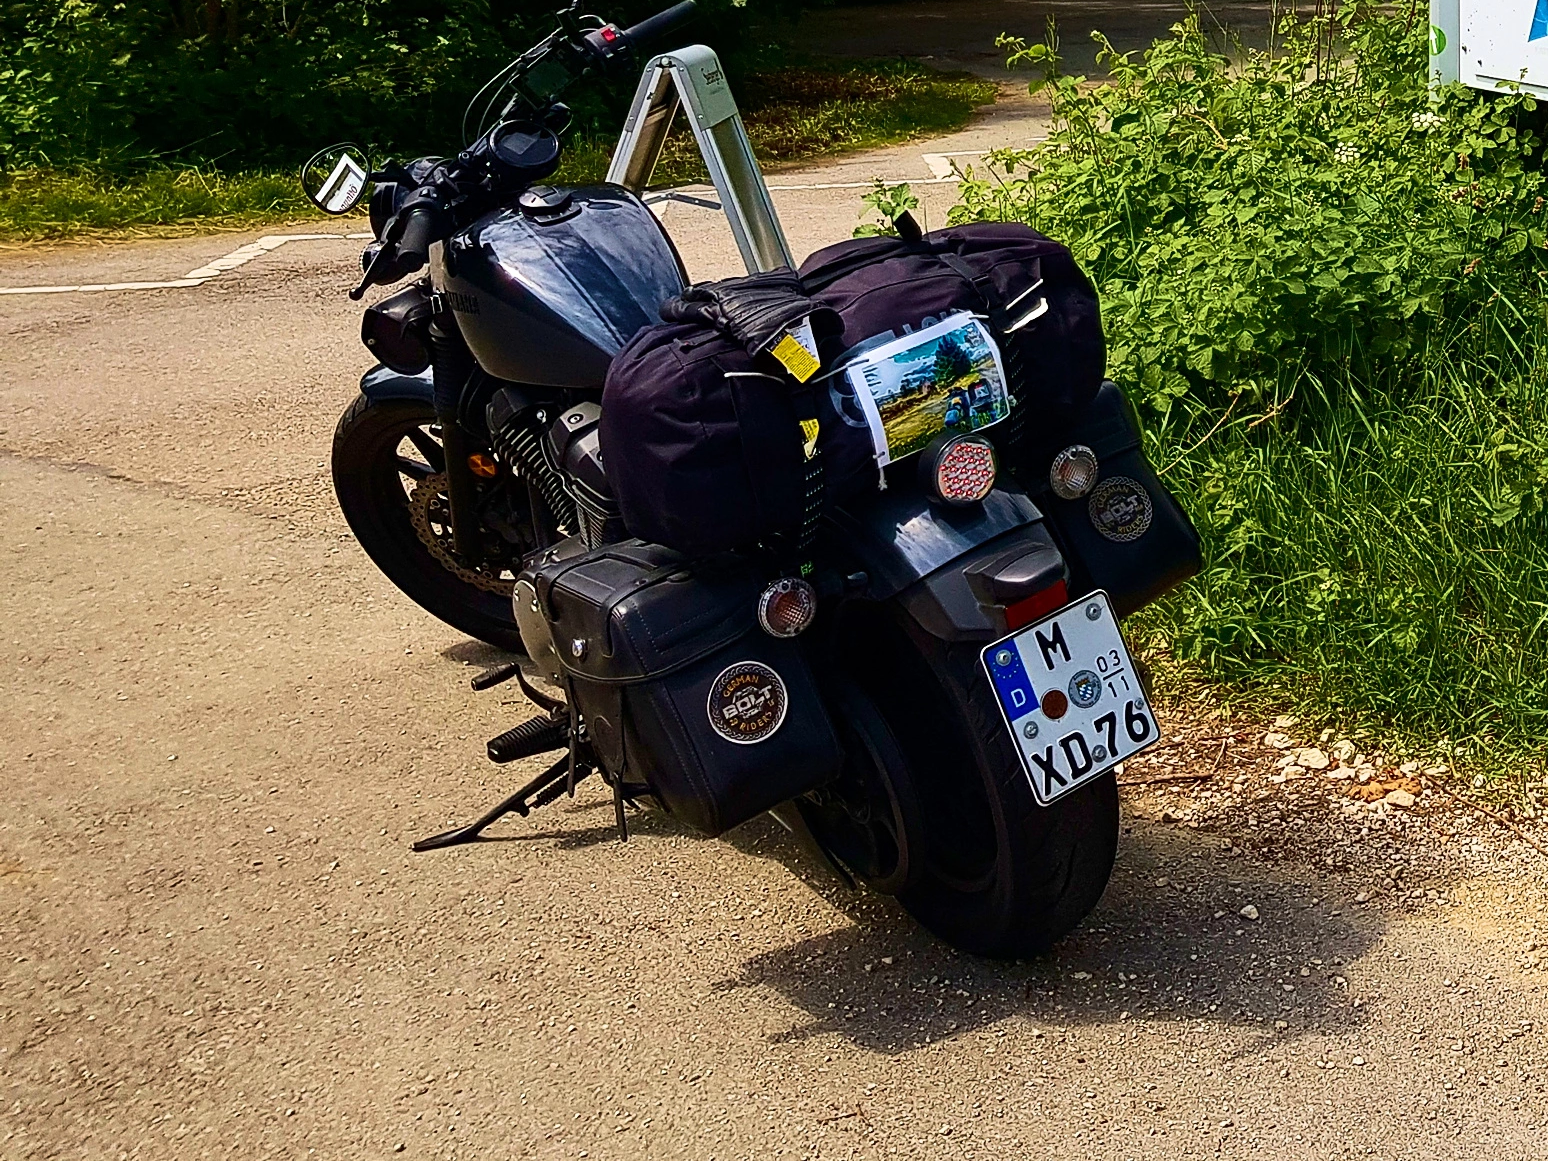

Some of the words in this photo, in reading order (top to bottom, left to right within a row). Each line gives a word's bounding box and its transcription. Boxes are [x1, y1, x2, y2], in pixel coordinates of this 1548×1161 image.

[1035, 622, 1071, 671] M
[1096, 649, 1120, 673] 03
[723, 675, 759, 697] GERMAN
[1108, 675, 1129, 697] 11
[722, 685, 772, 719] BOLT
[1011, 689, 1026, 707] D
[740, 711, 772, 731] RIDERS
[1031, 731, 1093, 796] XD
[1094, 701, 1150, 757] 76
